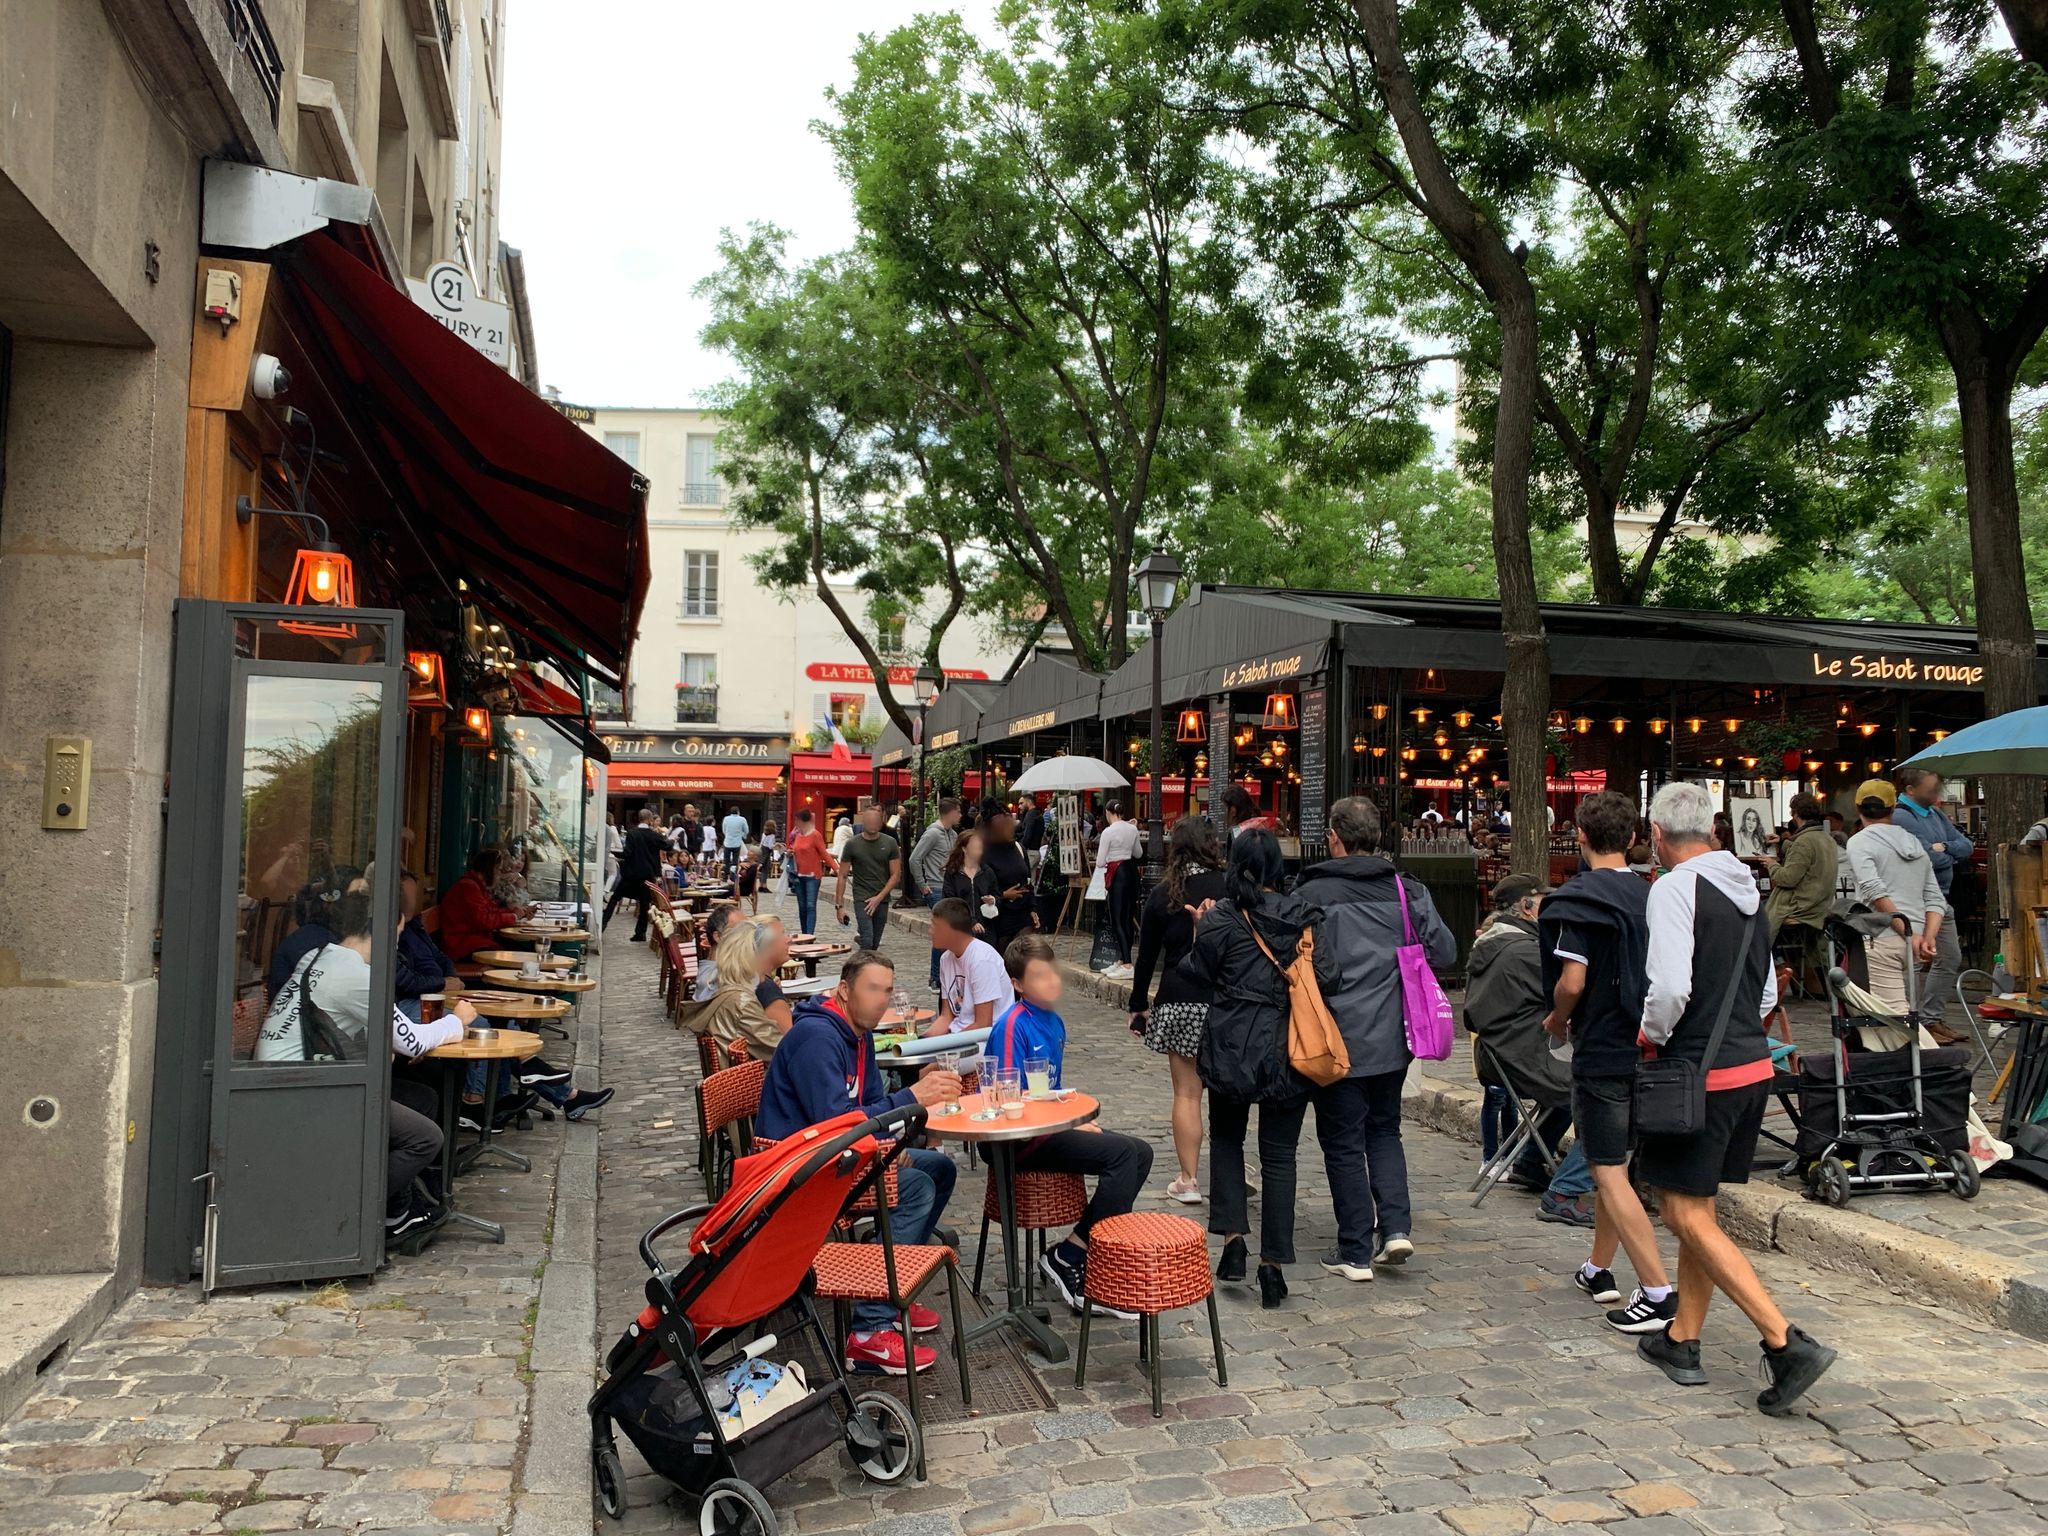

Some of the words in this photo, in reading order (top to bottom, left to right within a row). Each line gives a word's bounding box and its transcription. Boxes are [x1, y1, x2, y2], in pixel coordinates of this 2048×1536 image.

[432, 313, 483, 339] TURY
[487, 328, 503, 345] 21
[820, 665, 840, 678] LA
[843, 667, 876, 680] MER
[1222, 667, 1236, 688] Le
[1237, 657, 1269, 685] Sabot
[1270, 655, 1301, 678] rouge
[1813, 652, 1842, 676] Le
[1850, 655, 1918, 680] Sabot
[1923, 664, 1984, 685] rouge
[602, 735, 655, 754] PETIT
[671, 738, 769, 757] COMPTOIR
[652, 780, 676, 788] PASTA
[678, 780, 713, 788] BURGERS
